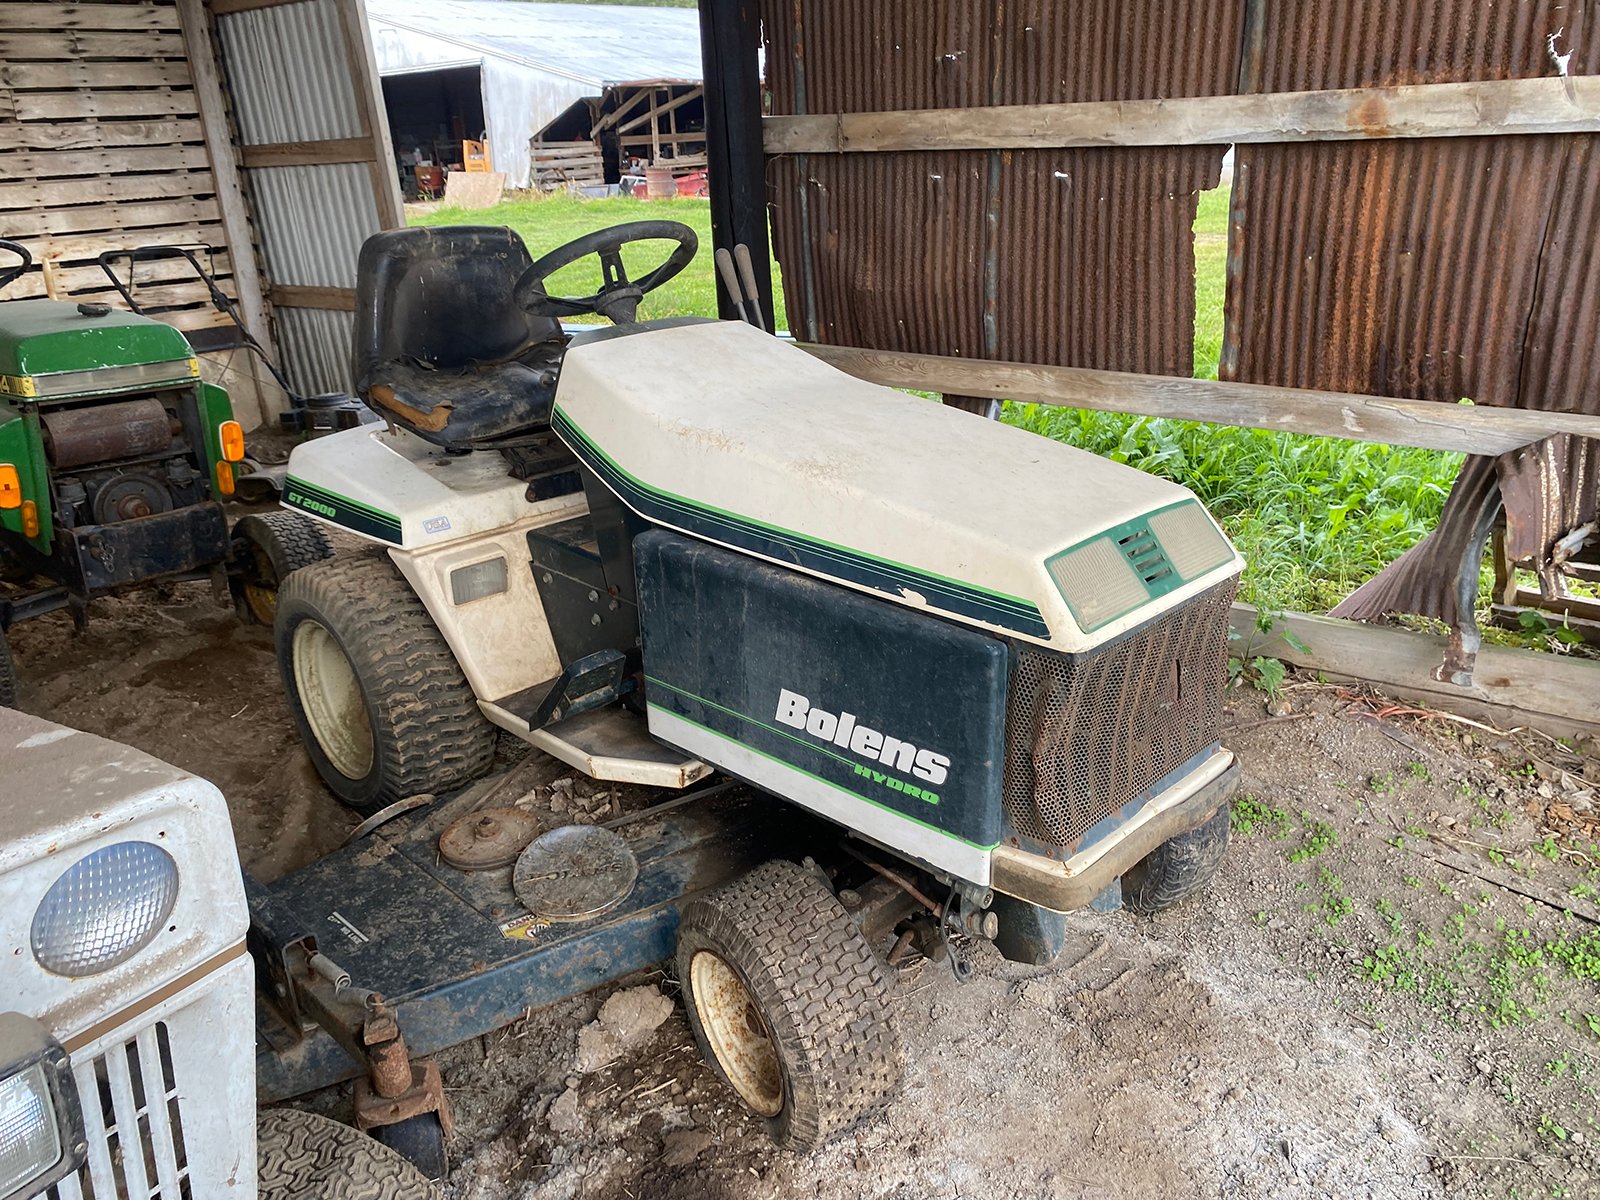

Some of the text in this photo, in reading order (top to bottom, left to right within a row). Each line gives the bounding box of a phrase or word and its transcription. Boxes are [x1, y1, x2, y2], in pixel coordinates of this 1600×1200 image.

[288, 492, 336, 518] GT 2000
[775, 688, 951, 785] Bolens
[853, 763, 941, 805] HYDRO
[508, 913, 538, 928] DANG
